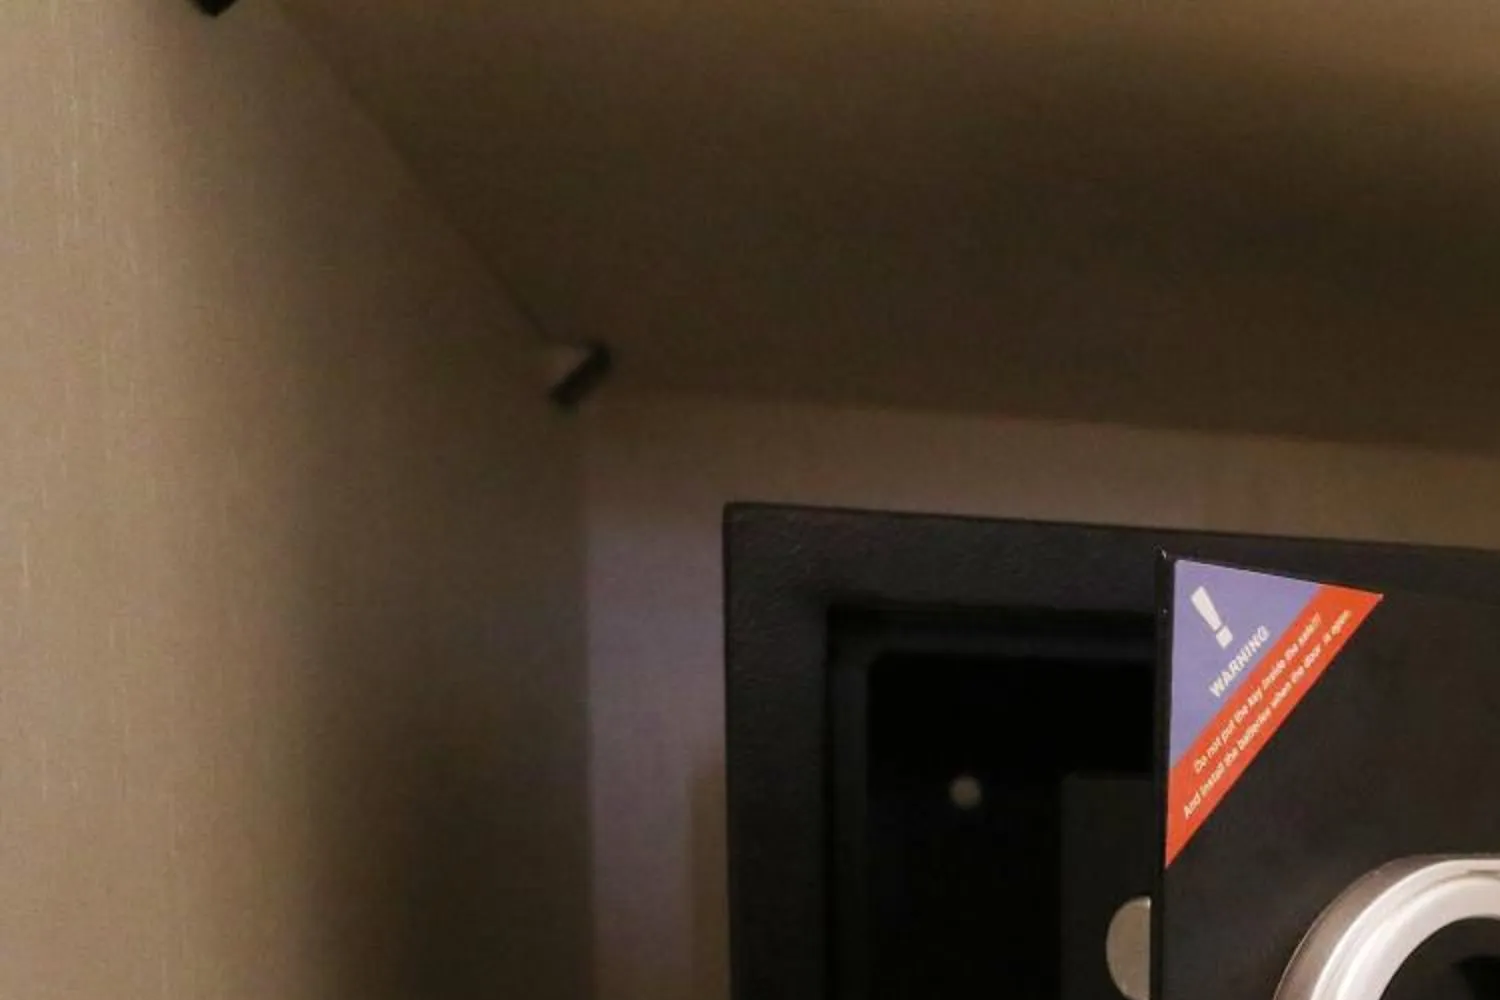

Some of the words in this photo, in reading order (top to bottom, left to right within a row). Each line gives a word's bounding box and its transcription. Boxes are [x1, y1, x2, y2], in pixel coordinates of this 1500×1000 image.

[1190, 586, 1233, 649] !
[1208, 625, 1270, 697] WARNING
[1184, 791, 1201, 820] And
[1223, 746, 1240, 767] the
[1271, 682, 1292, 709] when
[1290, 665, 1305, 684] the
[1303, 643, 1321, 669] door
[1207, 736, 1222, 759] not
[1221, 719, 1235, 744] put
[1233, 704, 1249, 723] the
[1247, 687, 1263, 708] key
[1261, 659, 1286, 691] inside
[1284, 643, 1299, 661] the
